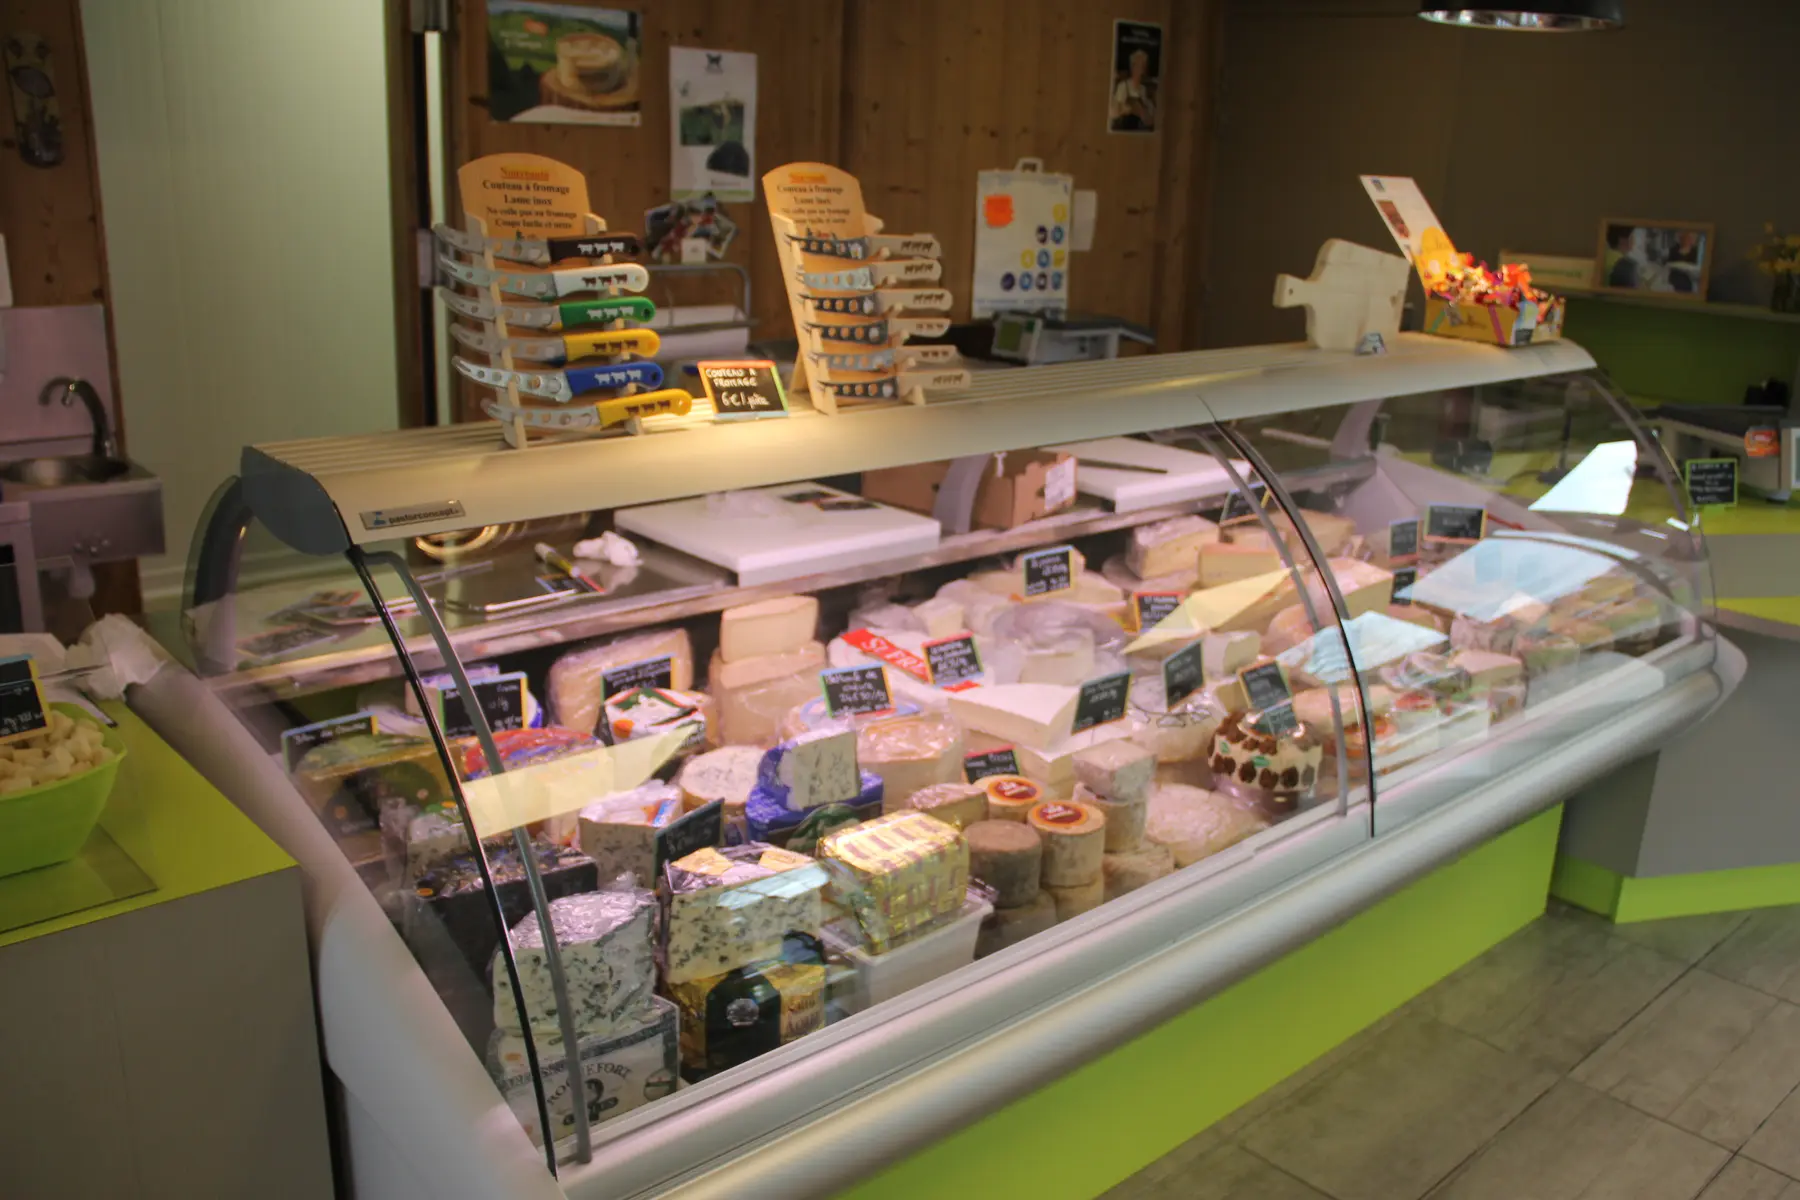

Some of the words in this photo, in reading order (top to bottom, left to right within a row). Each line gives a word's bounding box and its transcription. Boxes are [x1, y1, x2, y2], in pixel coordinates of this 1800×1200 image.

[482, 179, 523, 192] Couteau
[533, 182, 571, 195] fromage
[713, 377, 759, 388] FROMAGE
